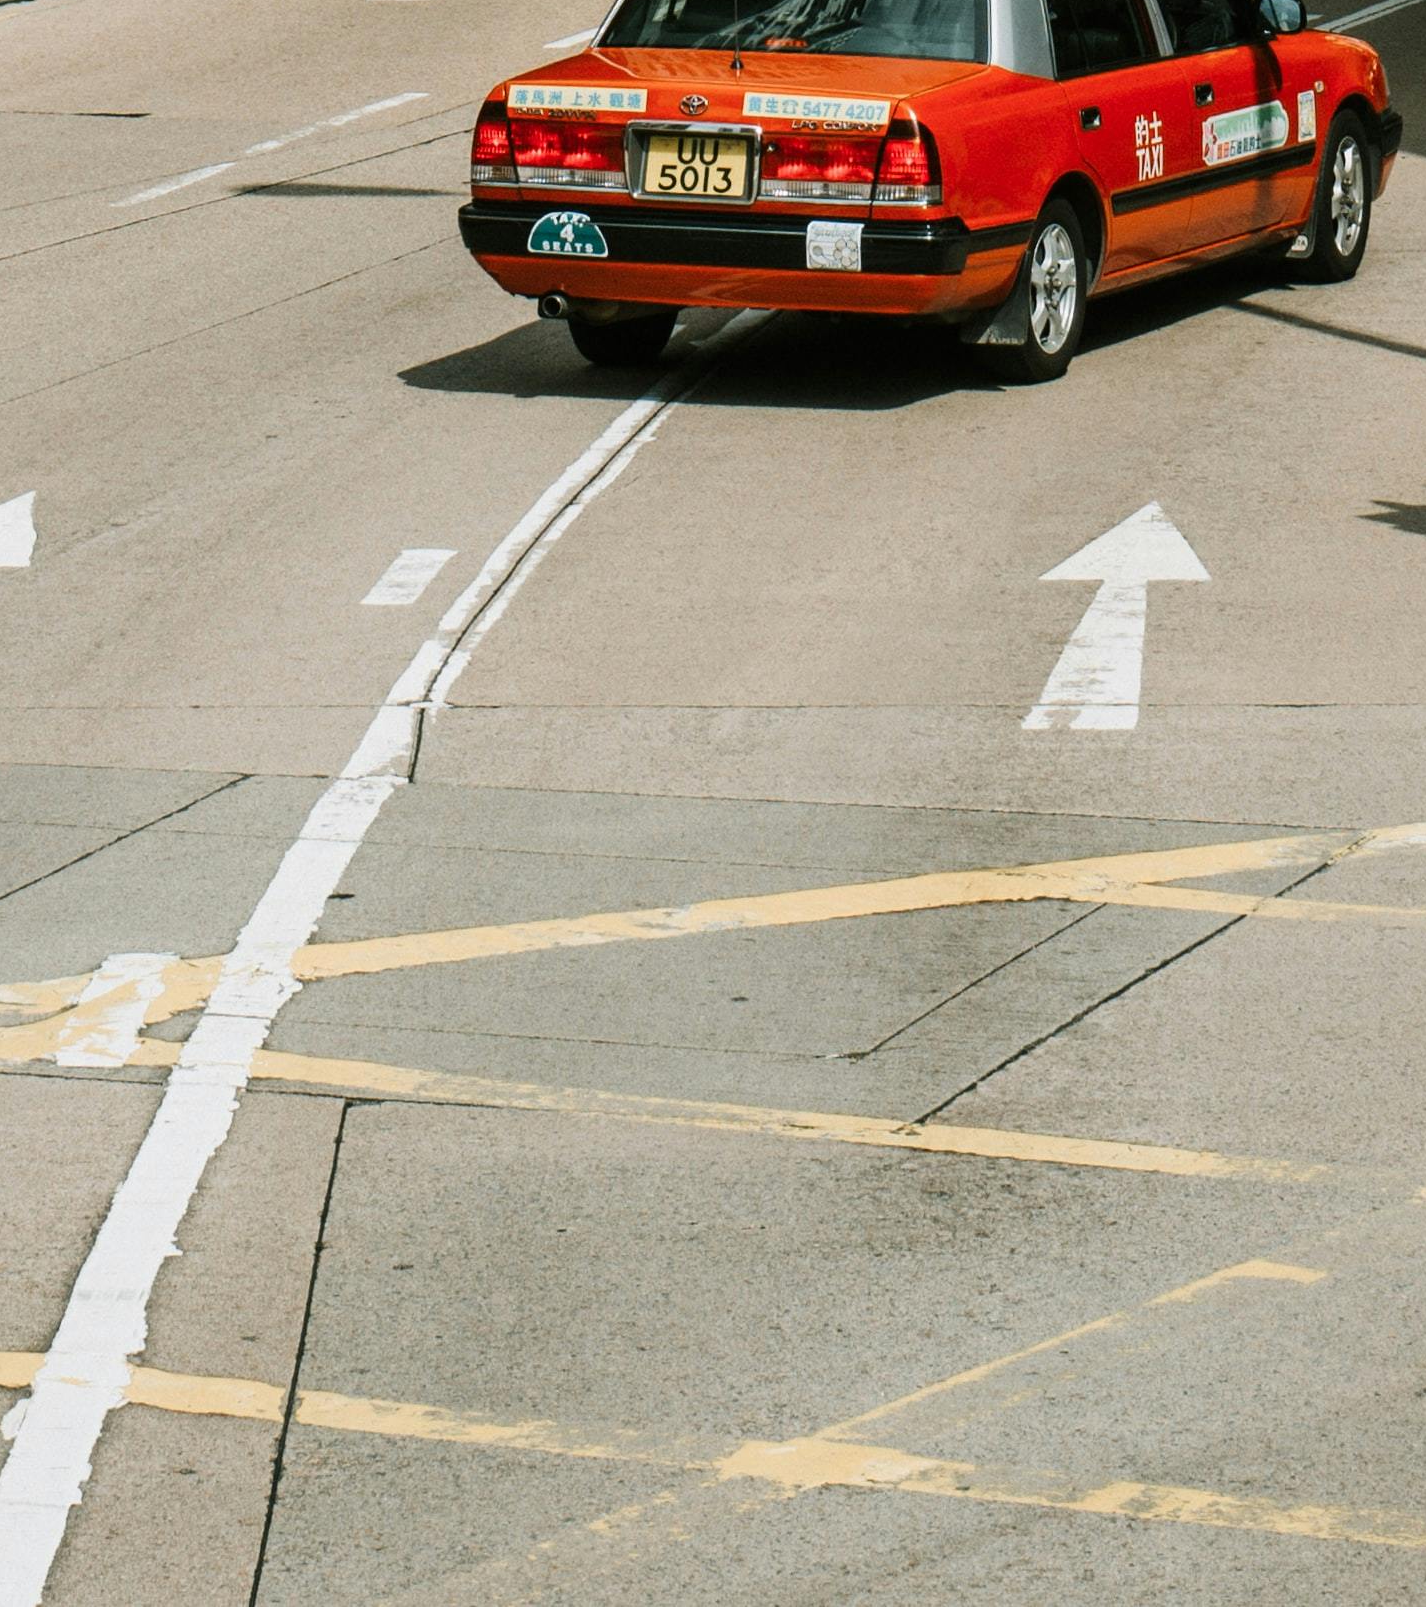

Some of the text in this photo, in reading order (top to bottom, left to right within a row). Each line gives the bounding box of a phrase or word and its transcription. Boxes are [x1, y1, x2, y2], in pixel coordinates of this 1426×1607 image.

[571, 91, 601, 107] 上水
[802, 100, 843, 118] 5477
[845, 103, 886, 121] 4207
[1135, 110, 1163, 146] 的士
[677, 137, 719, 165] UU
[1135, 143, 1164, 182] TAXI
[658, 165, 732, 193] 5013
[559, 224, 574, 242] 4
[542, 240, 594, 253] SEATS
